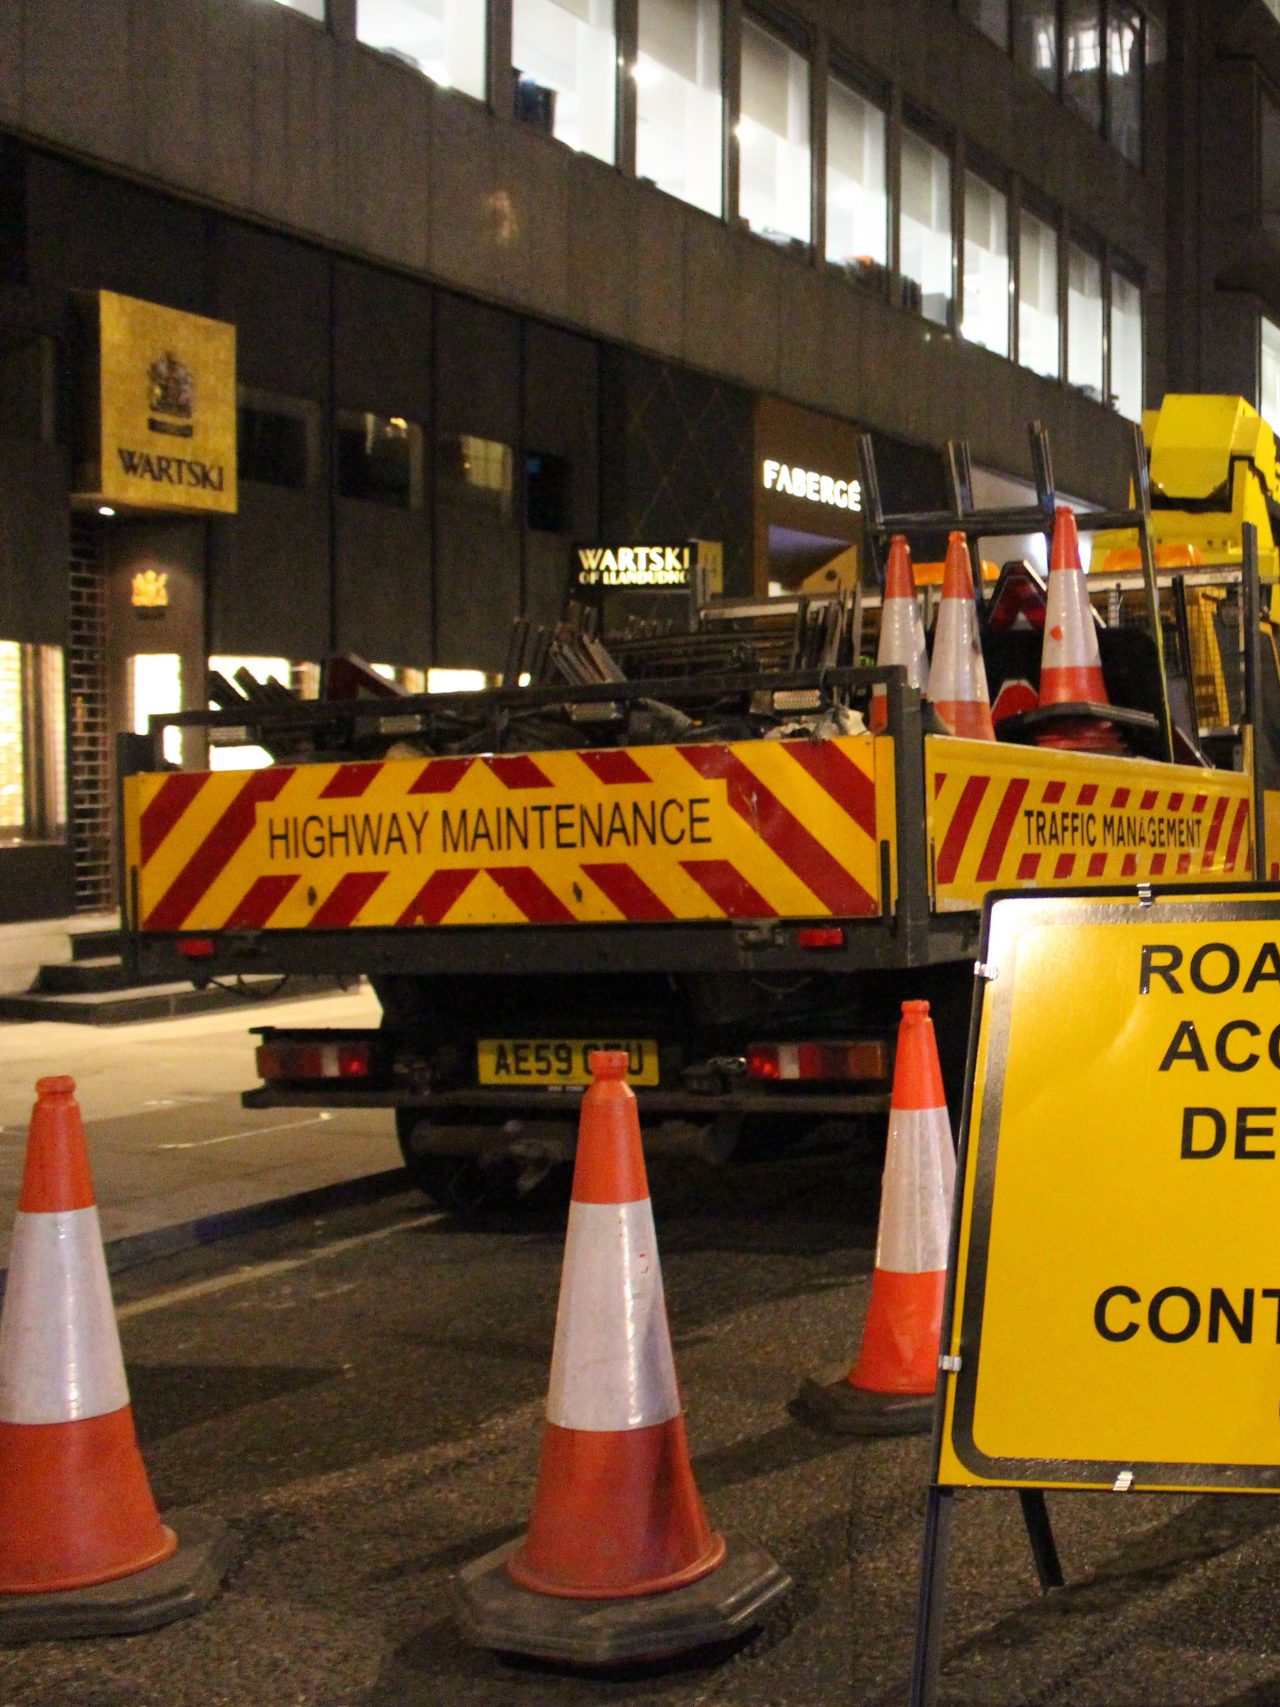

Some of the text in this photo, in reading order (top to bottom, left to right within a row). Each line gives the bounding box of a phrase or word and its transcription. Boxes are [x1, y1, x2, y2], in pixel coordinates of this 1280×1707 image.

[117, 448, 224, 492] WARTSKI
[578, 547, 690, 571] WARTSKI
[578, 571, 600, 584] OF
[268, 798, 711, 859] HIGHWAY MAINTENANCE
[1024, 810, 1202, 848] TRAFFIC MANAGEMENT
[495, 1043, 573, 1075] AE59
